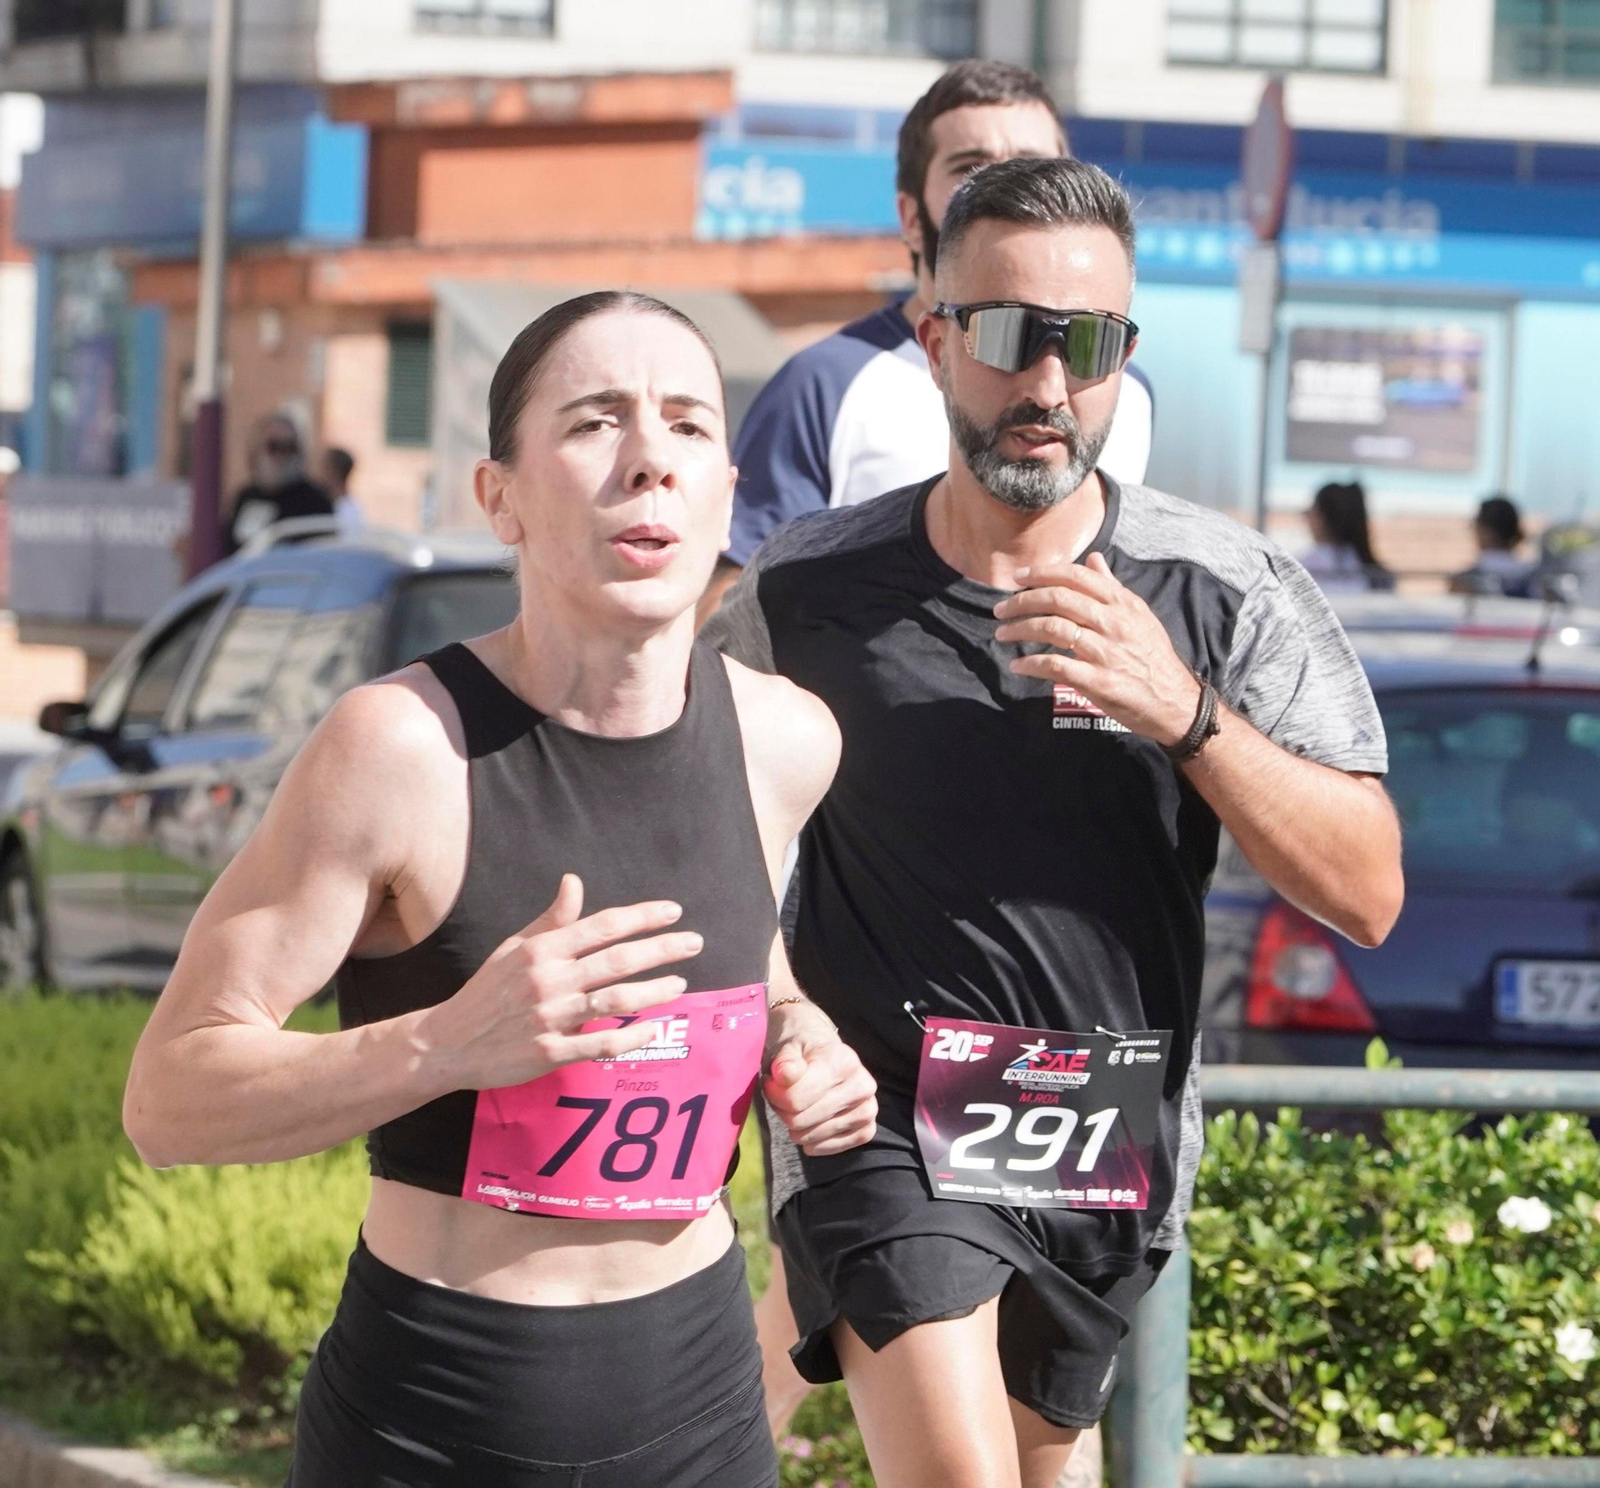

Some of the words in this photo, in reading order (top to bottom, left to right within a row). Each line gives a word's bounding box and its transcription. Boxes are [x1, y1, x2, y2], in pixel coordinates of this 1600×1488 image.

[1053, 717, 1091, 730] CINTAS
[929, 1028, 975, 1062] 20
[974, 1034, 995, 1047] SEP
[595, 1047, 690, 1062] ERRUNNING
[1027, 1051, 1090, 1073] CAE
[1006, 1069, 1087, 1083] INTERRUNNING
[1019, 1091, 1060, 1104] M.ROA
[536, 1093, 708, 1183] 781
[949, 1102, 1120, 1172] 291
